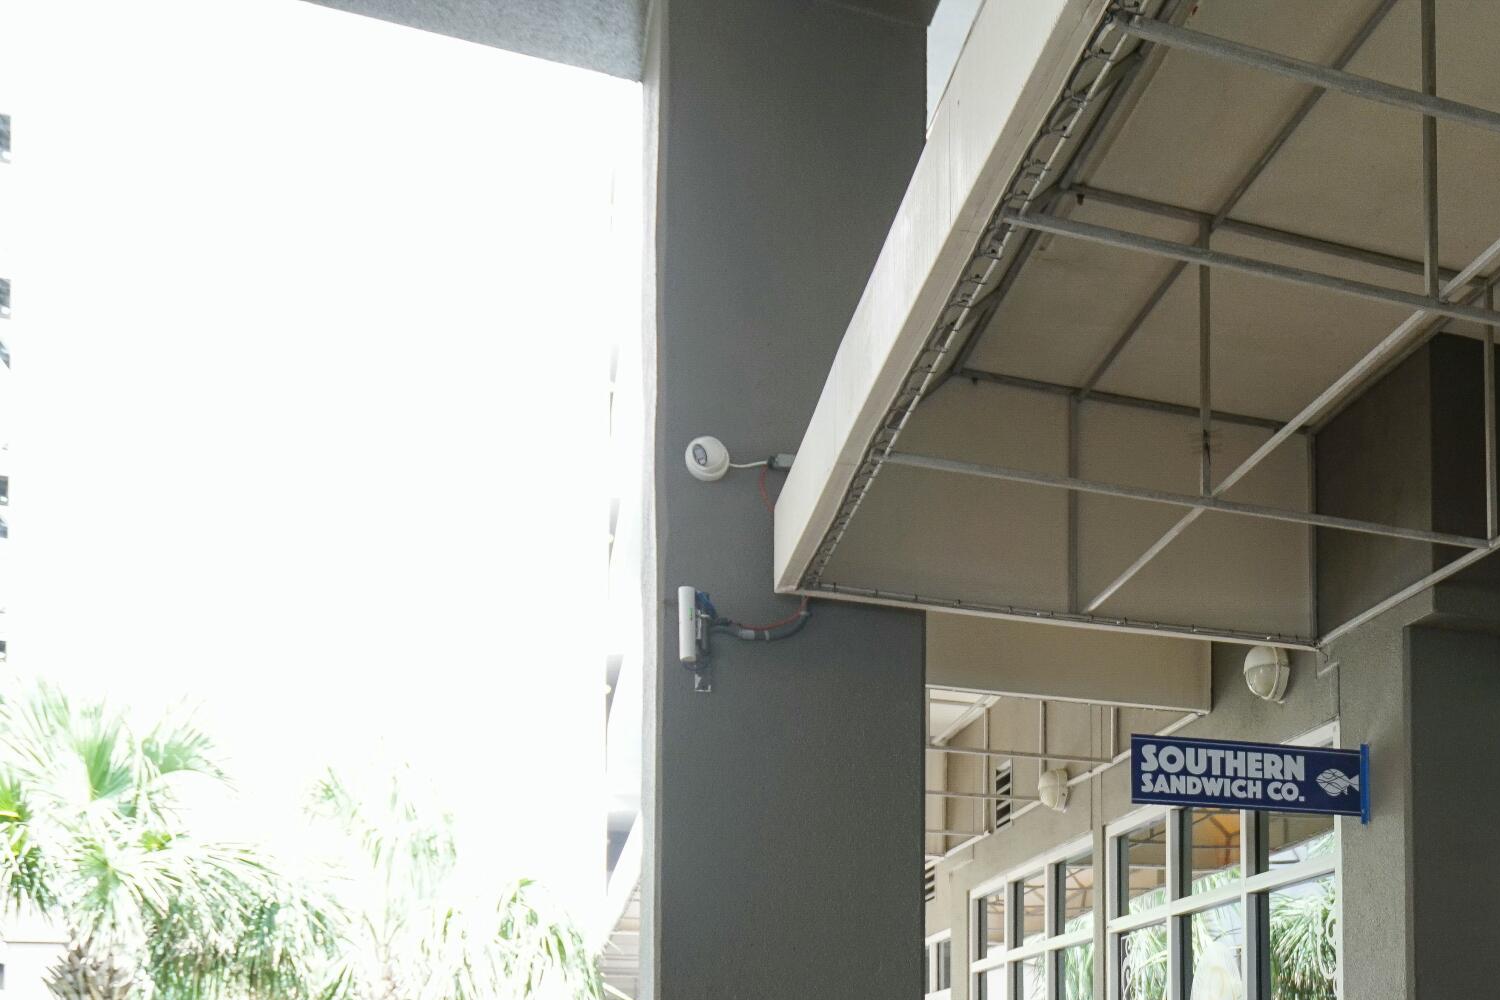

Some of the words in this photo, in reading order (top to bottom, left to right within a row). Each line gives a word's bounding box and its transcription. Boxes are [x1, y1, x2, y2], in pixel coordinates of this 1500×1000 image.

[1141, 745, 1305, 781] SOUTHERN
[1141, 773, 1262, 799] SANDWICH
[1267, 782, 1305, 801] CO.
